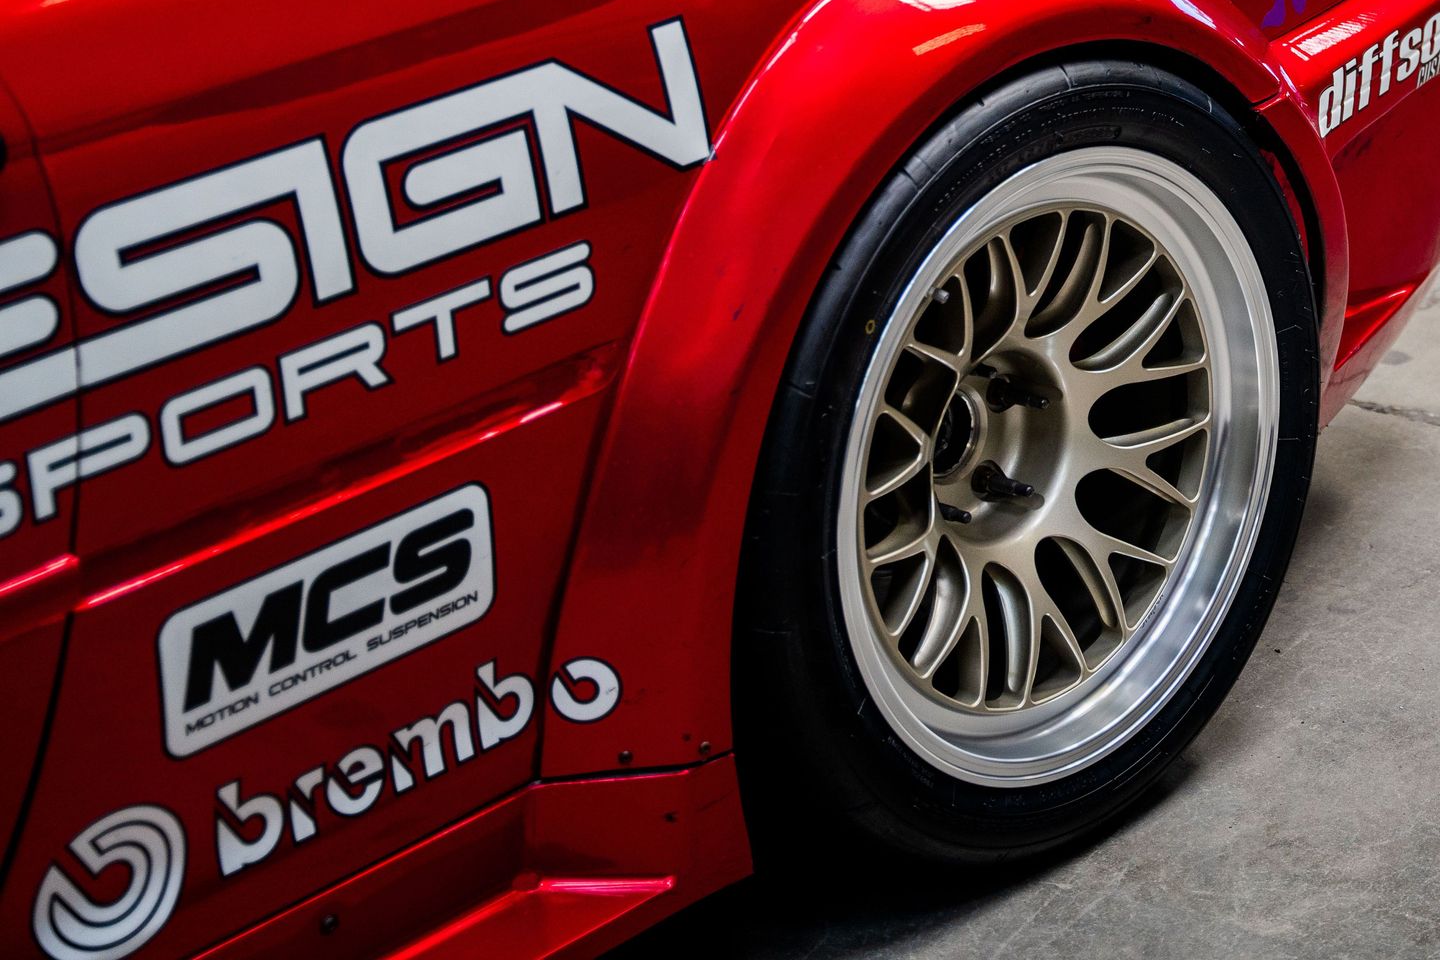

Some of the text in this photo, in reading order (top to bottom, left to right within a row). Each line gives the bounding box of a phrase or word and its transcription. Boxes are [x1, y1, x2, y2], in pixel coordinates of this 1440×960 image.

[0, 240, 595, 540] PORTS
[181, 505, 475, 713] MCS
[185, 590, 478, 736] MOTION CONTROL SUSPENSION
[215, 656, 622, 878] brembo
